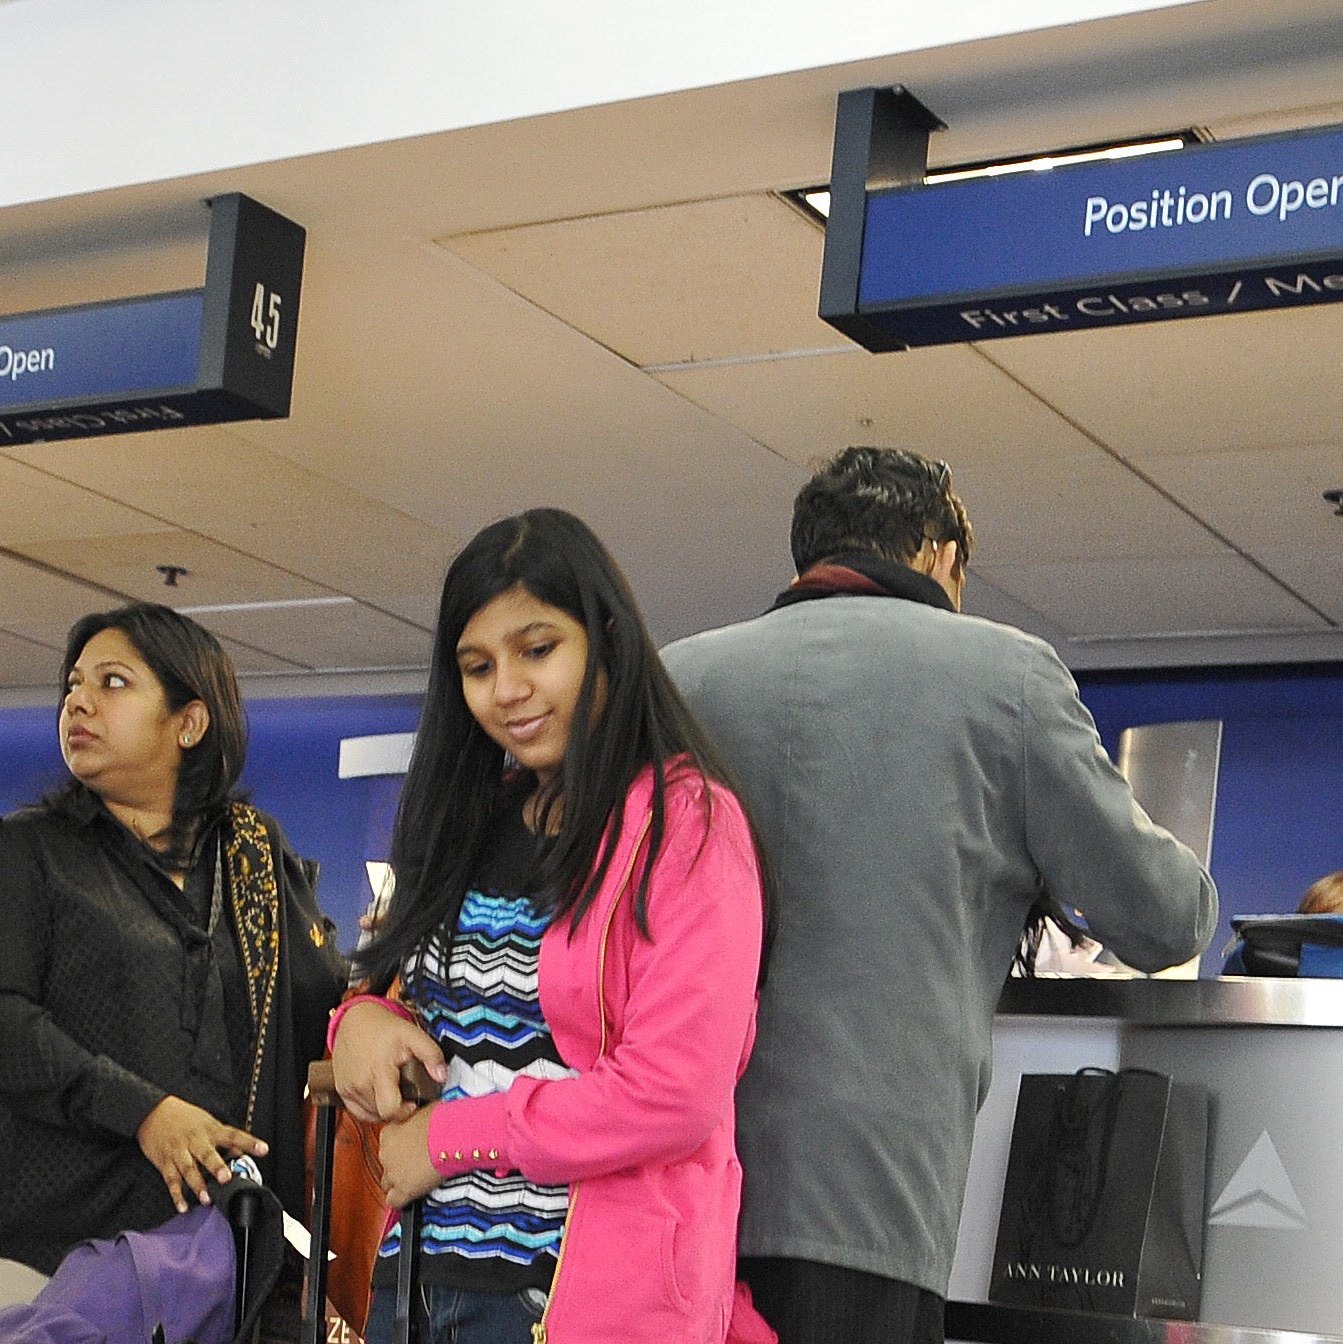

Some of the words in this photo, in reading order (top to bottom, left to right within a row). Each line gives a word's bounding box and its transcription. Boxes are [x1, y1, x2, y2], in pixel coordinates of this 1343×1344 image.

[1083, 185, 1233, 237] Position
[250, 281, 282, 349] 45
[960, 303, 1070, 330] First
[1076, 288, 1211, 318] Class
[1225, 279, 1243, 305] /
[1003, 1261, 1042, 1280] ANN
[1047, 1264, 1125, 1288] TAYLOR
